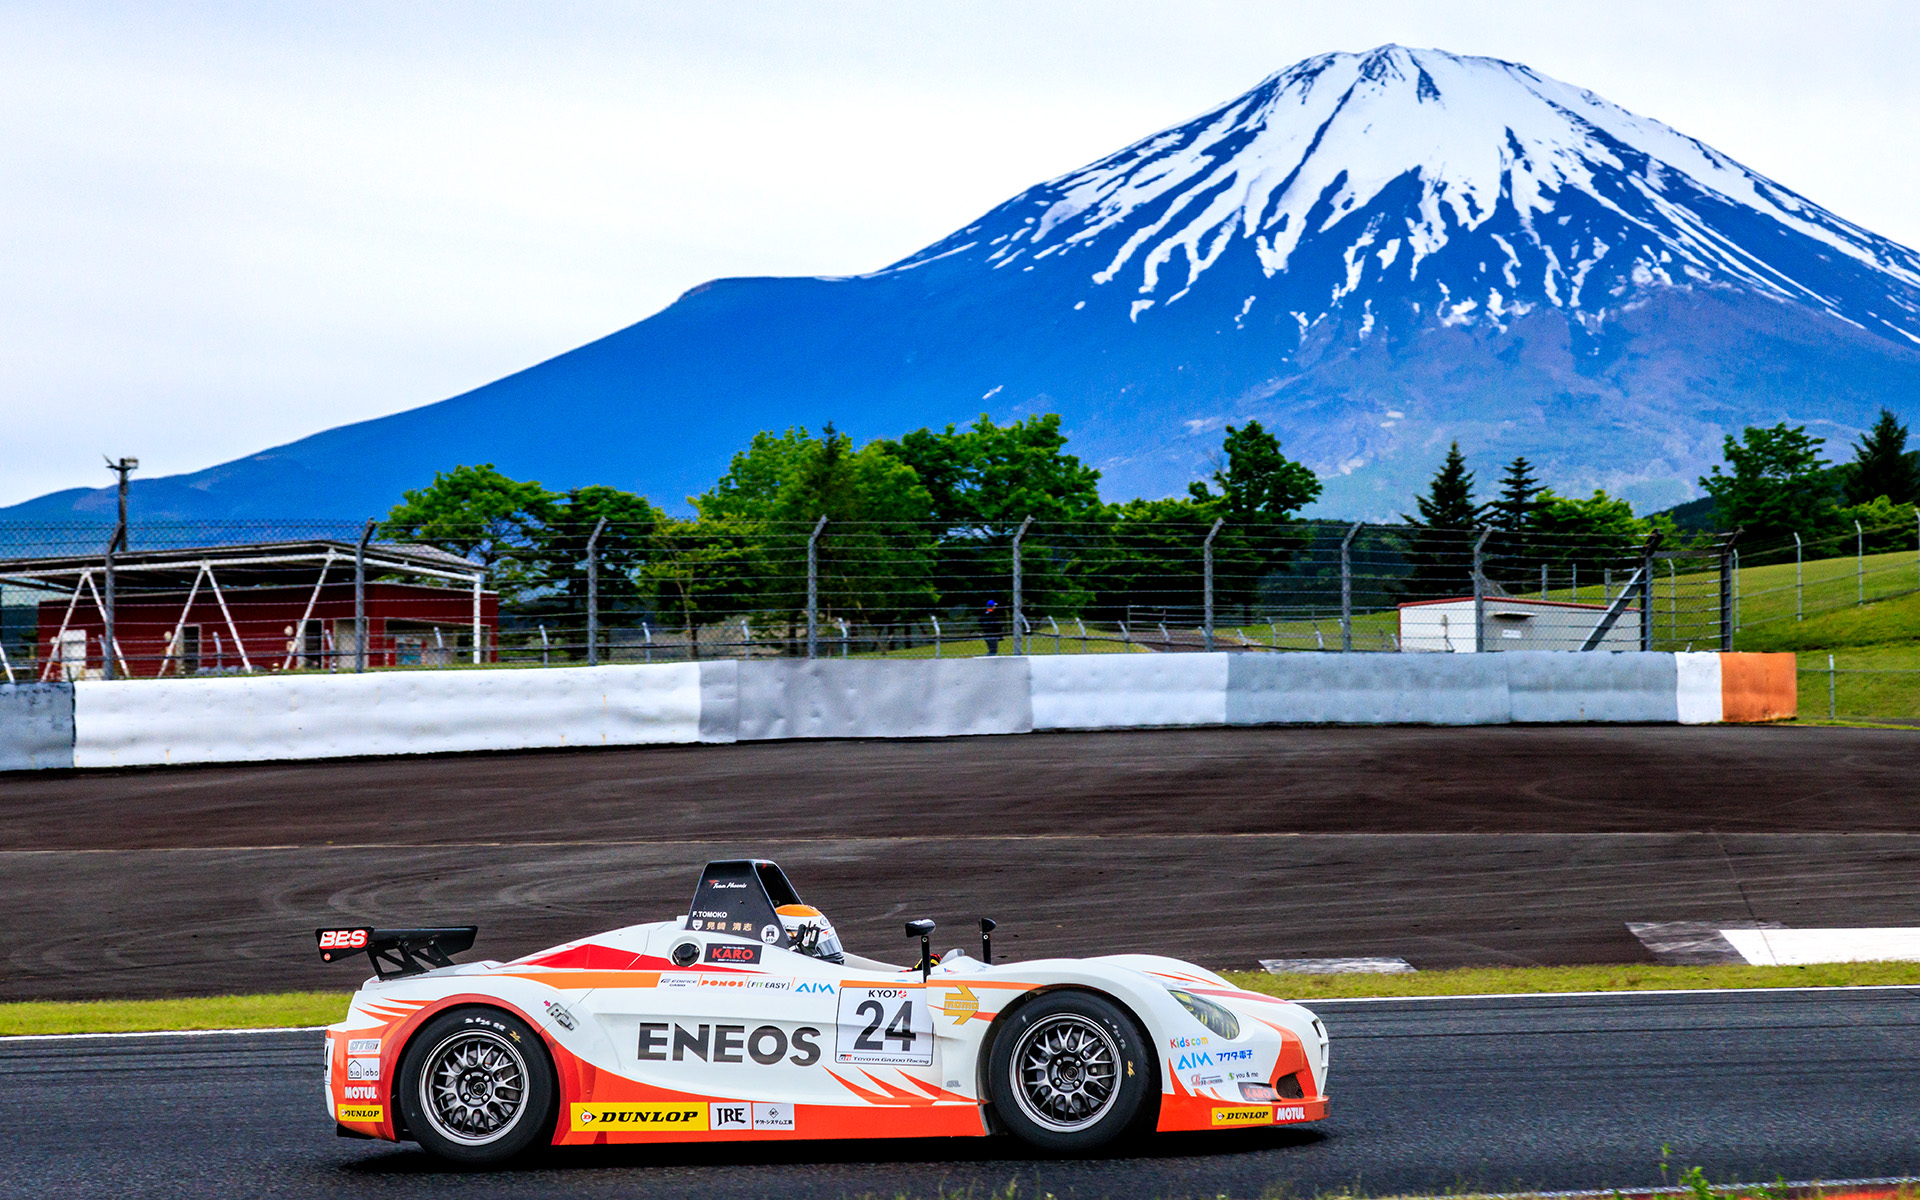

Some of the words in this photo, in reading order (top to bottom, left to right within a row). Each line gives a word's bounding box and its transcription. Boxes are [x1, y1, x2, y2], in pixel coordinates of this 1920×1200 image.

[692, 910, 728, 918] F.TOMOKO
[712, 948, 753, 960] KARO
[700, 980, 744, 988] PONOS
[853, 999, 917, 1052] 24
[637, 1022, 822, 1067] ENEOS
[344, 1086, 377, 1099] MOTUL
[601, 1111, 698, 1122] DUNLOP
[1226, 1112, 1269, 1120] DUNLOP
[1276, 1107, 1305, 1121] MOTUL
